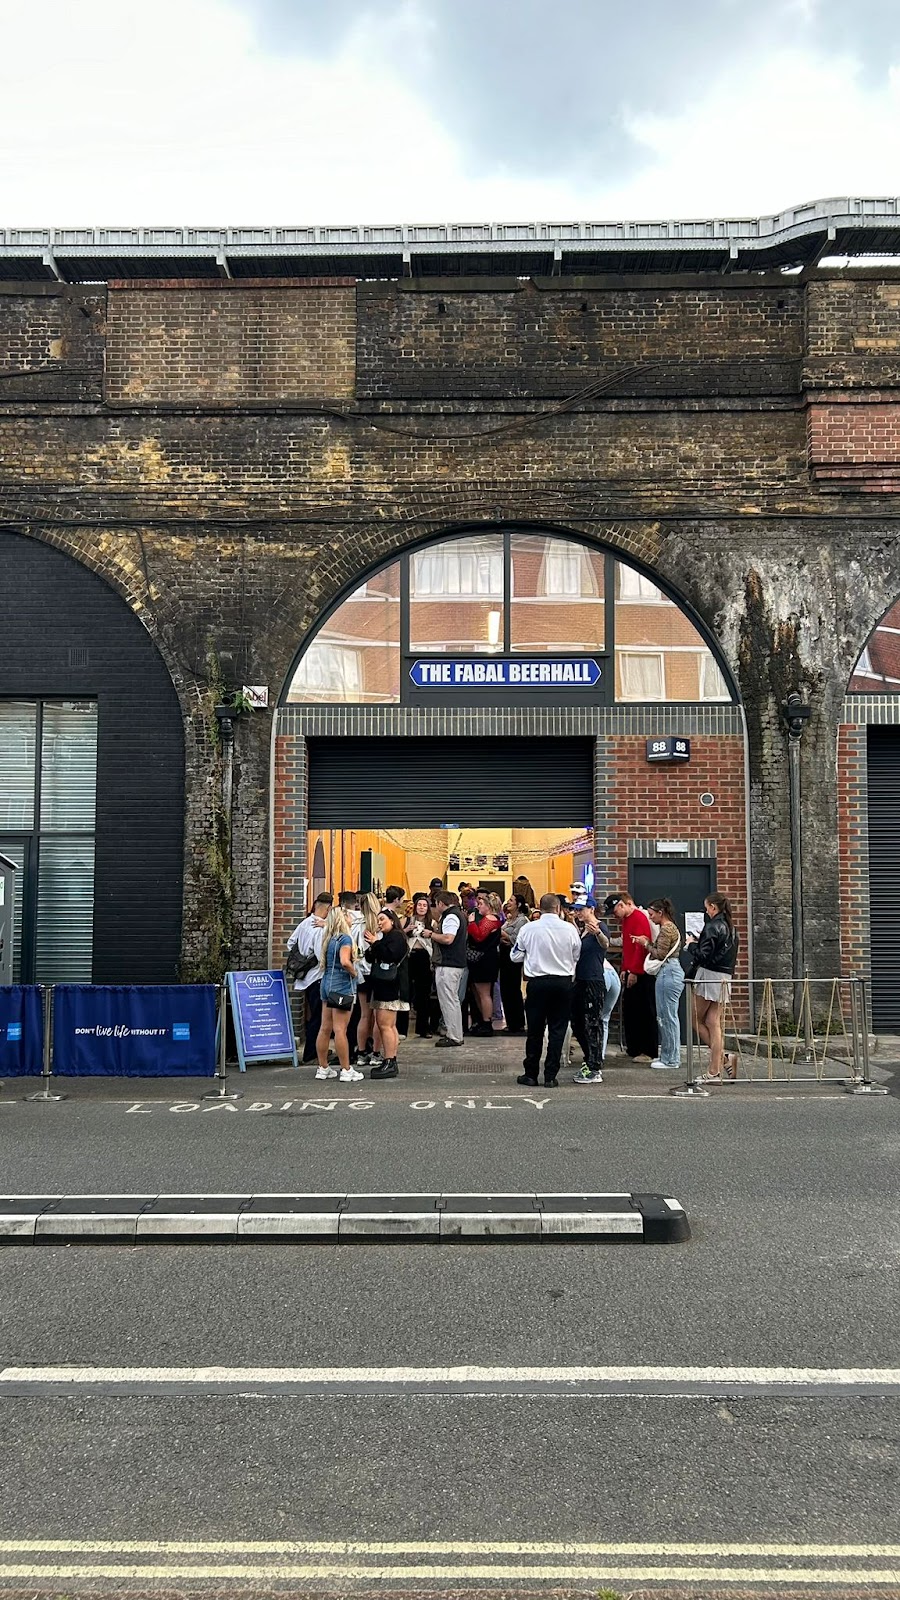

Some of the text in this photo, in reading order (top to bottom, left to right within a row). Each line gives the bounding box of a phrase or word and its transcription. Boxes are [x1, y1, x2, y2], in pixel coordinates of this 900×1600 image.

[419, 663, 591, 682] THE FABAL BEERHALL
[652, 741, 667, 752] 88
[675, 741, 686, 752] 88
[249, 976, 270, 984] FABAL
[96, 1025, 114, 1037] live
[113, 1025, 131, 1038] life
[125, 1098, 551, 1113] LOADING ONLY
